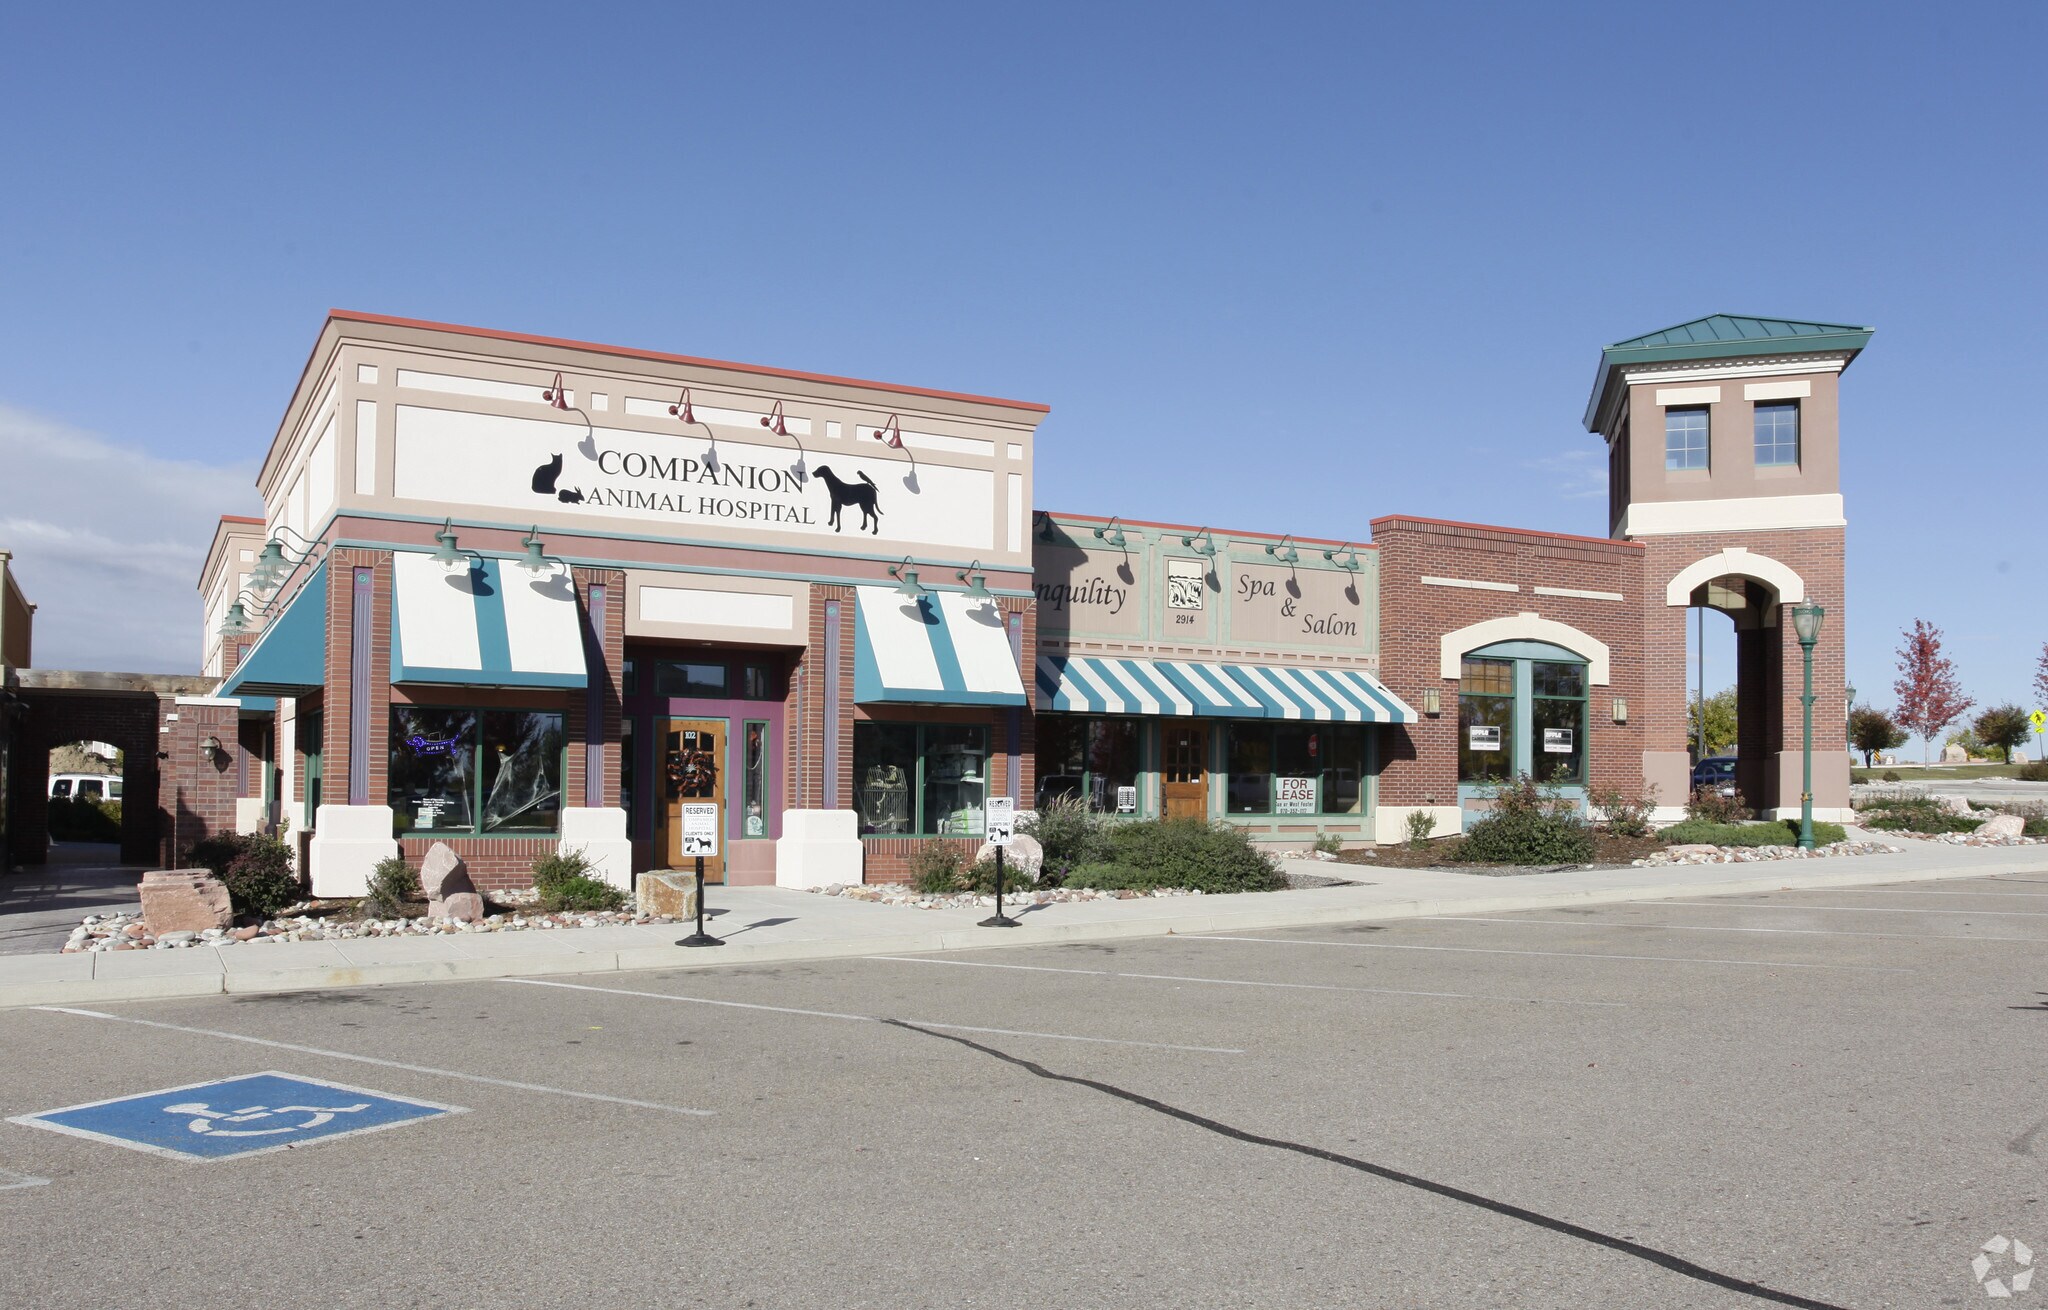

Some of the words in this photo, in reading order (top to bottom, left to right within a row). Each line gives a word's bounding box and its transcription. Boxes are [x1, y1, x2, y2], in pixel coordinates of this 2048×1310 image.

[598, 450, 804, 494] COMPANION
[587, 487, 692, 513] ANIMAL
[699, 497, 816, 525] HOSPITAL
[1033, 577, 1127, 615] nquility
[1238, 574, 1276, 603] Spa
[1281, 598, 1297, 618] &
[1175, 614, 1195, 625] 2914
[1302, 614, 1358, 637] Salon
[685, 731, 696, 739] 102
[1283, 779, 1308, 789] FOR
[1276, 790, 1314, 800] LEASE
